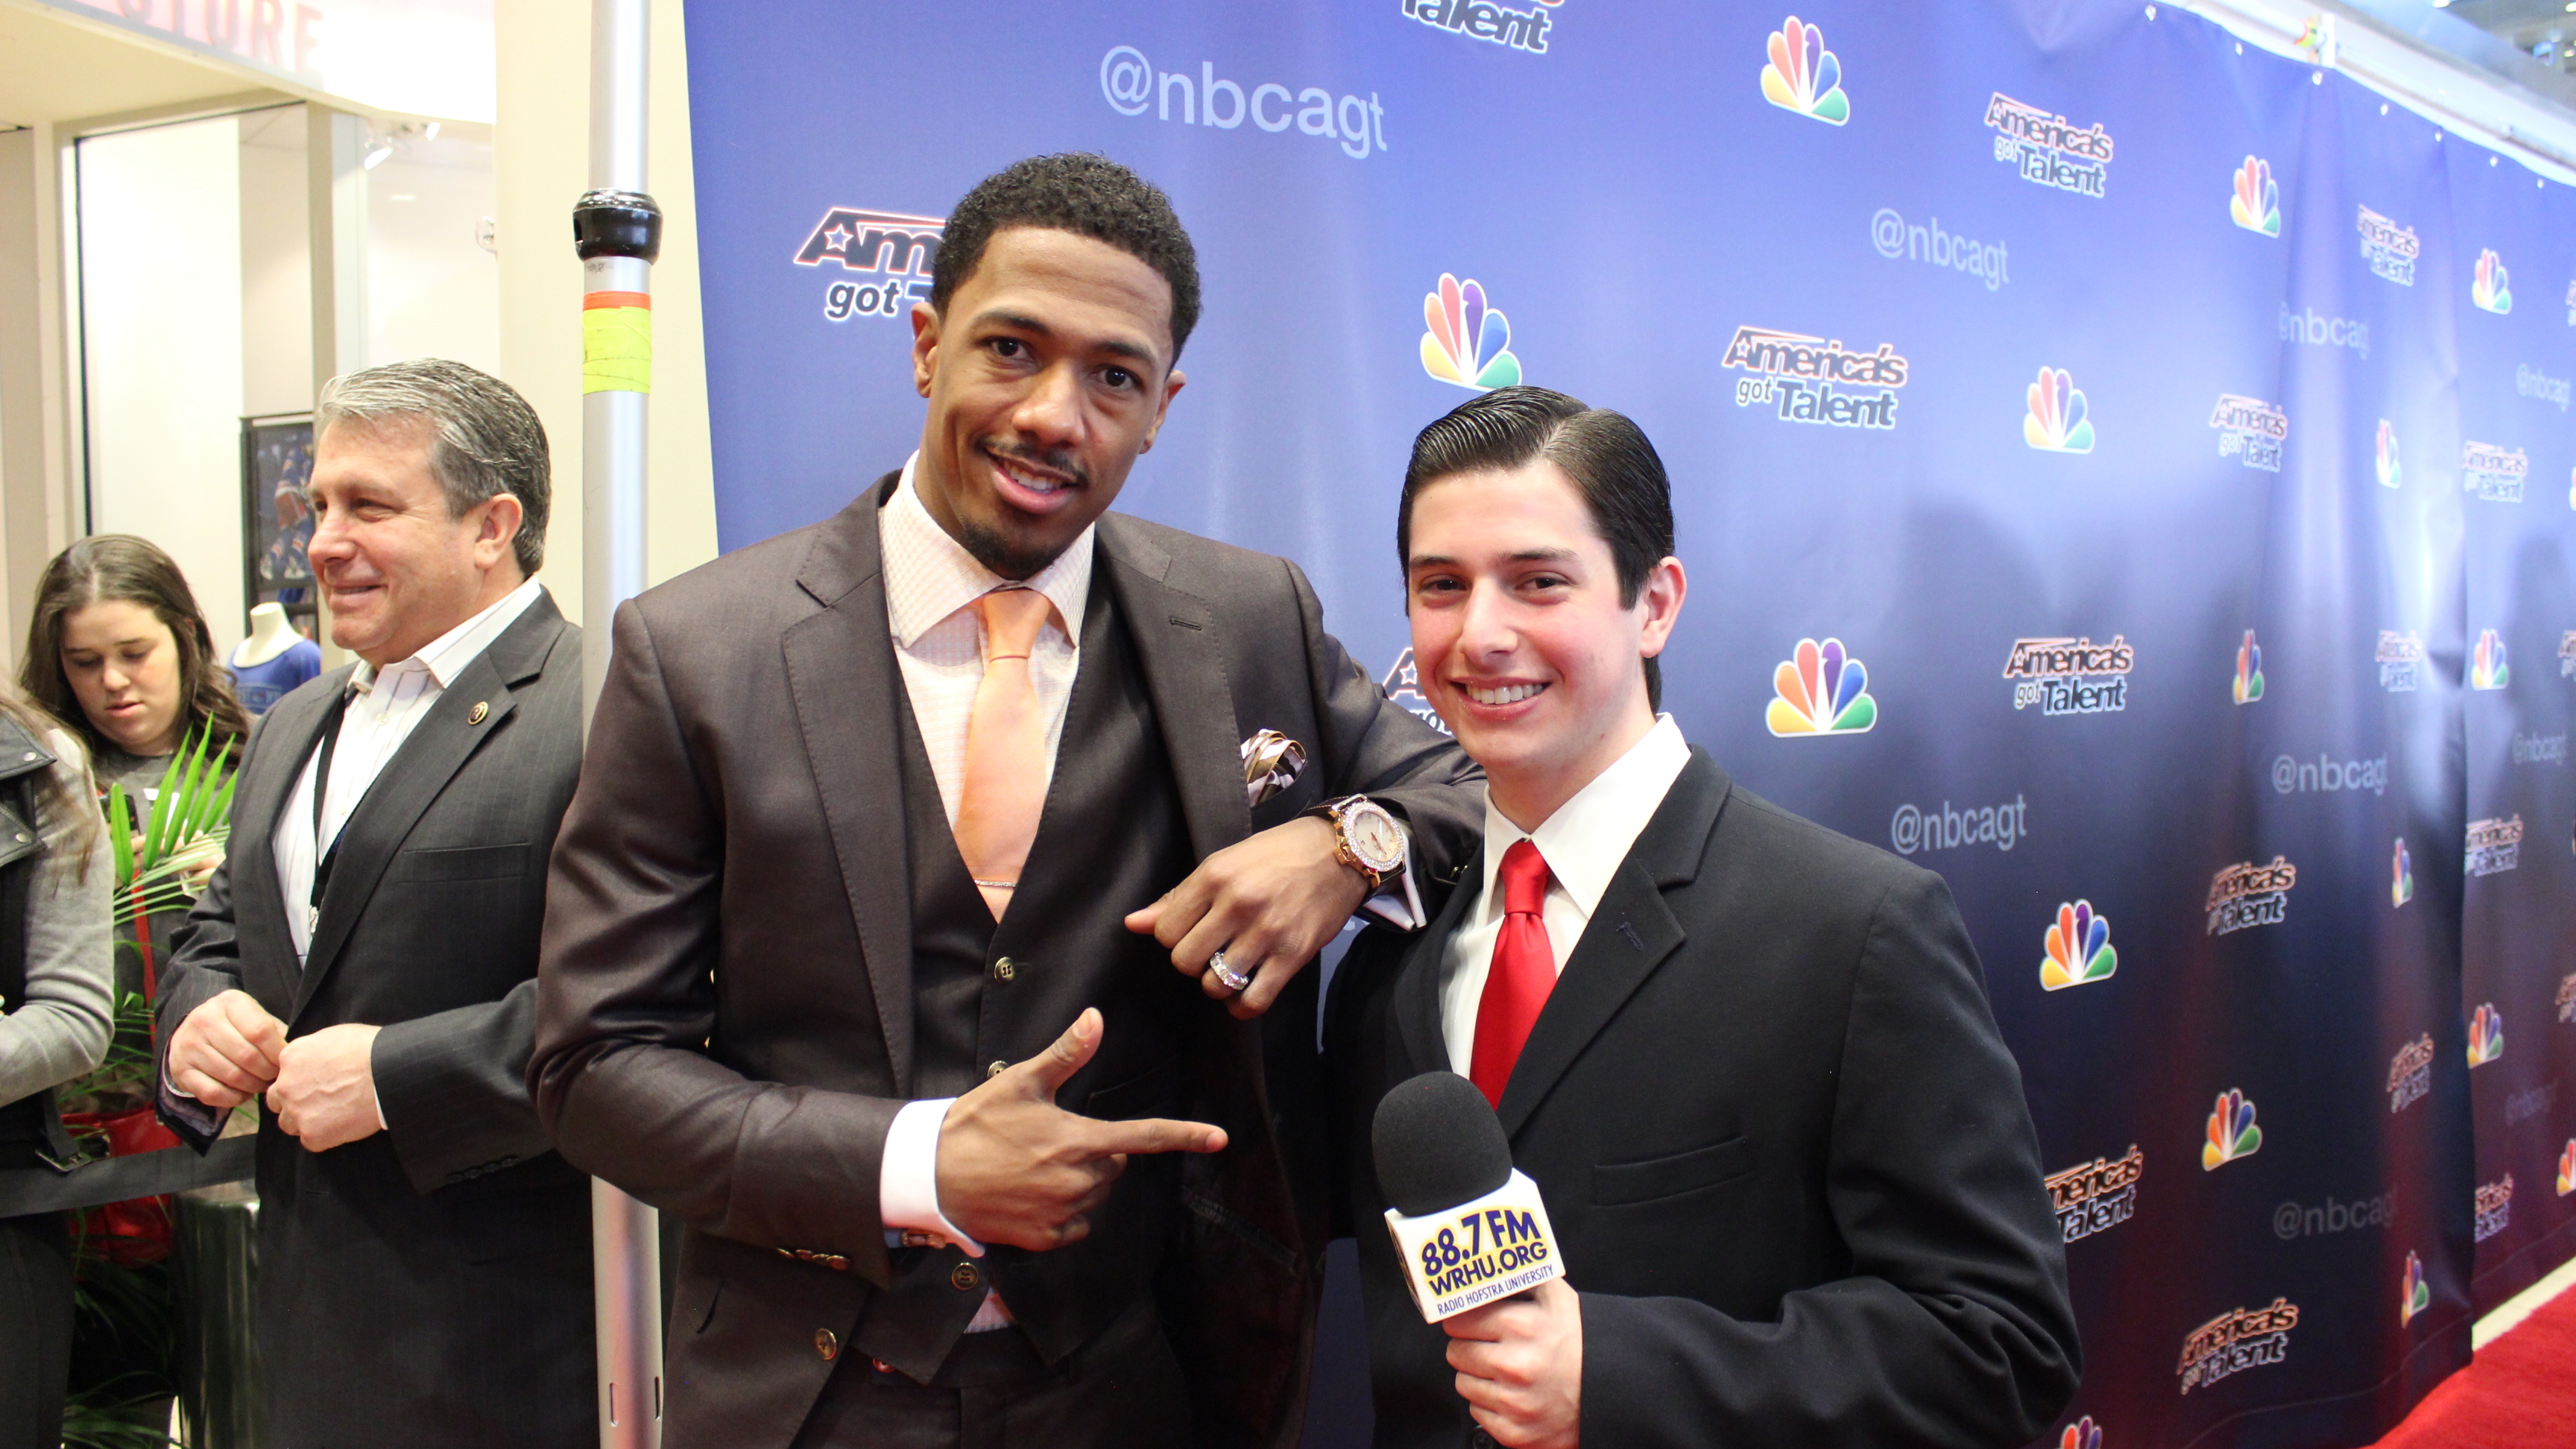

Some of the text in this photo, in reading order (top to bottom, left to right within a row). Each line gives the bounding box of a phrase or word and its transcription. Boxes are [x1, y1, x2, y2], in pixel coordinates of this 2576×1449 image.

[1100, 45, 1387, 160] @nbcagt
[1983, 92, 2114, 163] America's
[1994, 136, 2106, 198] got Talent
[1871, 208, 2010, 292] @nbcagt
[824, 279, 901, 323] got
[1721, 326, 1908, 388] America's
[2279, 301, 2369, 359] @nbcag
[1736, 376, 1898, 429] got Talent
[2516, 363, 2571, 412] @nbcag
[2003, 635, 2134, 678] America's
[2014, 675, 2127, 716] got Talent
[1892, 793, 2027, 855] @nbcagt
[2044, 1143, 2144, 1210] merica's
[2055, 1183, 2136, 1243] Talent
[2273, 1187, 2396, 1240] @nbcag
[1429, 1242, 1547, 1296] WRHU.ORG
[1437, 1265, 1554, 1316] RADIO HOFSTRA UNIVERSITY
[2199, 1331, 2289, 1388] Talent
